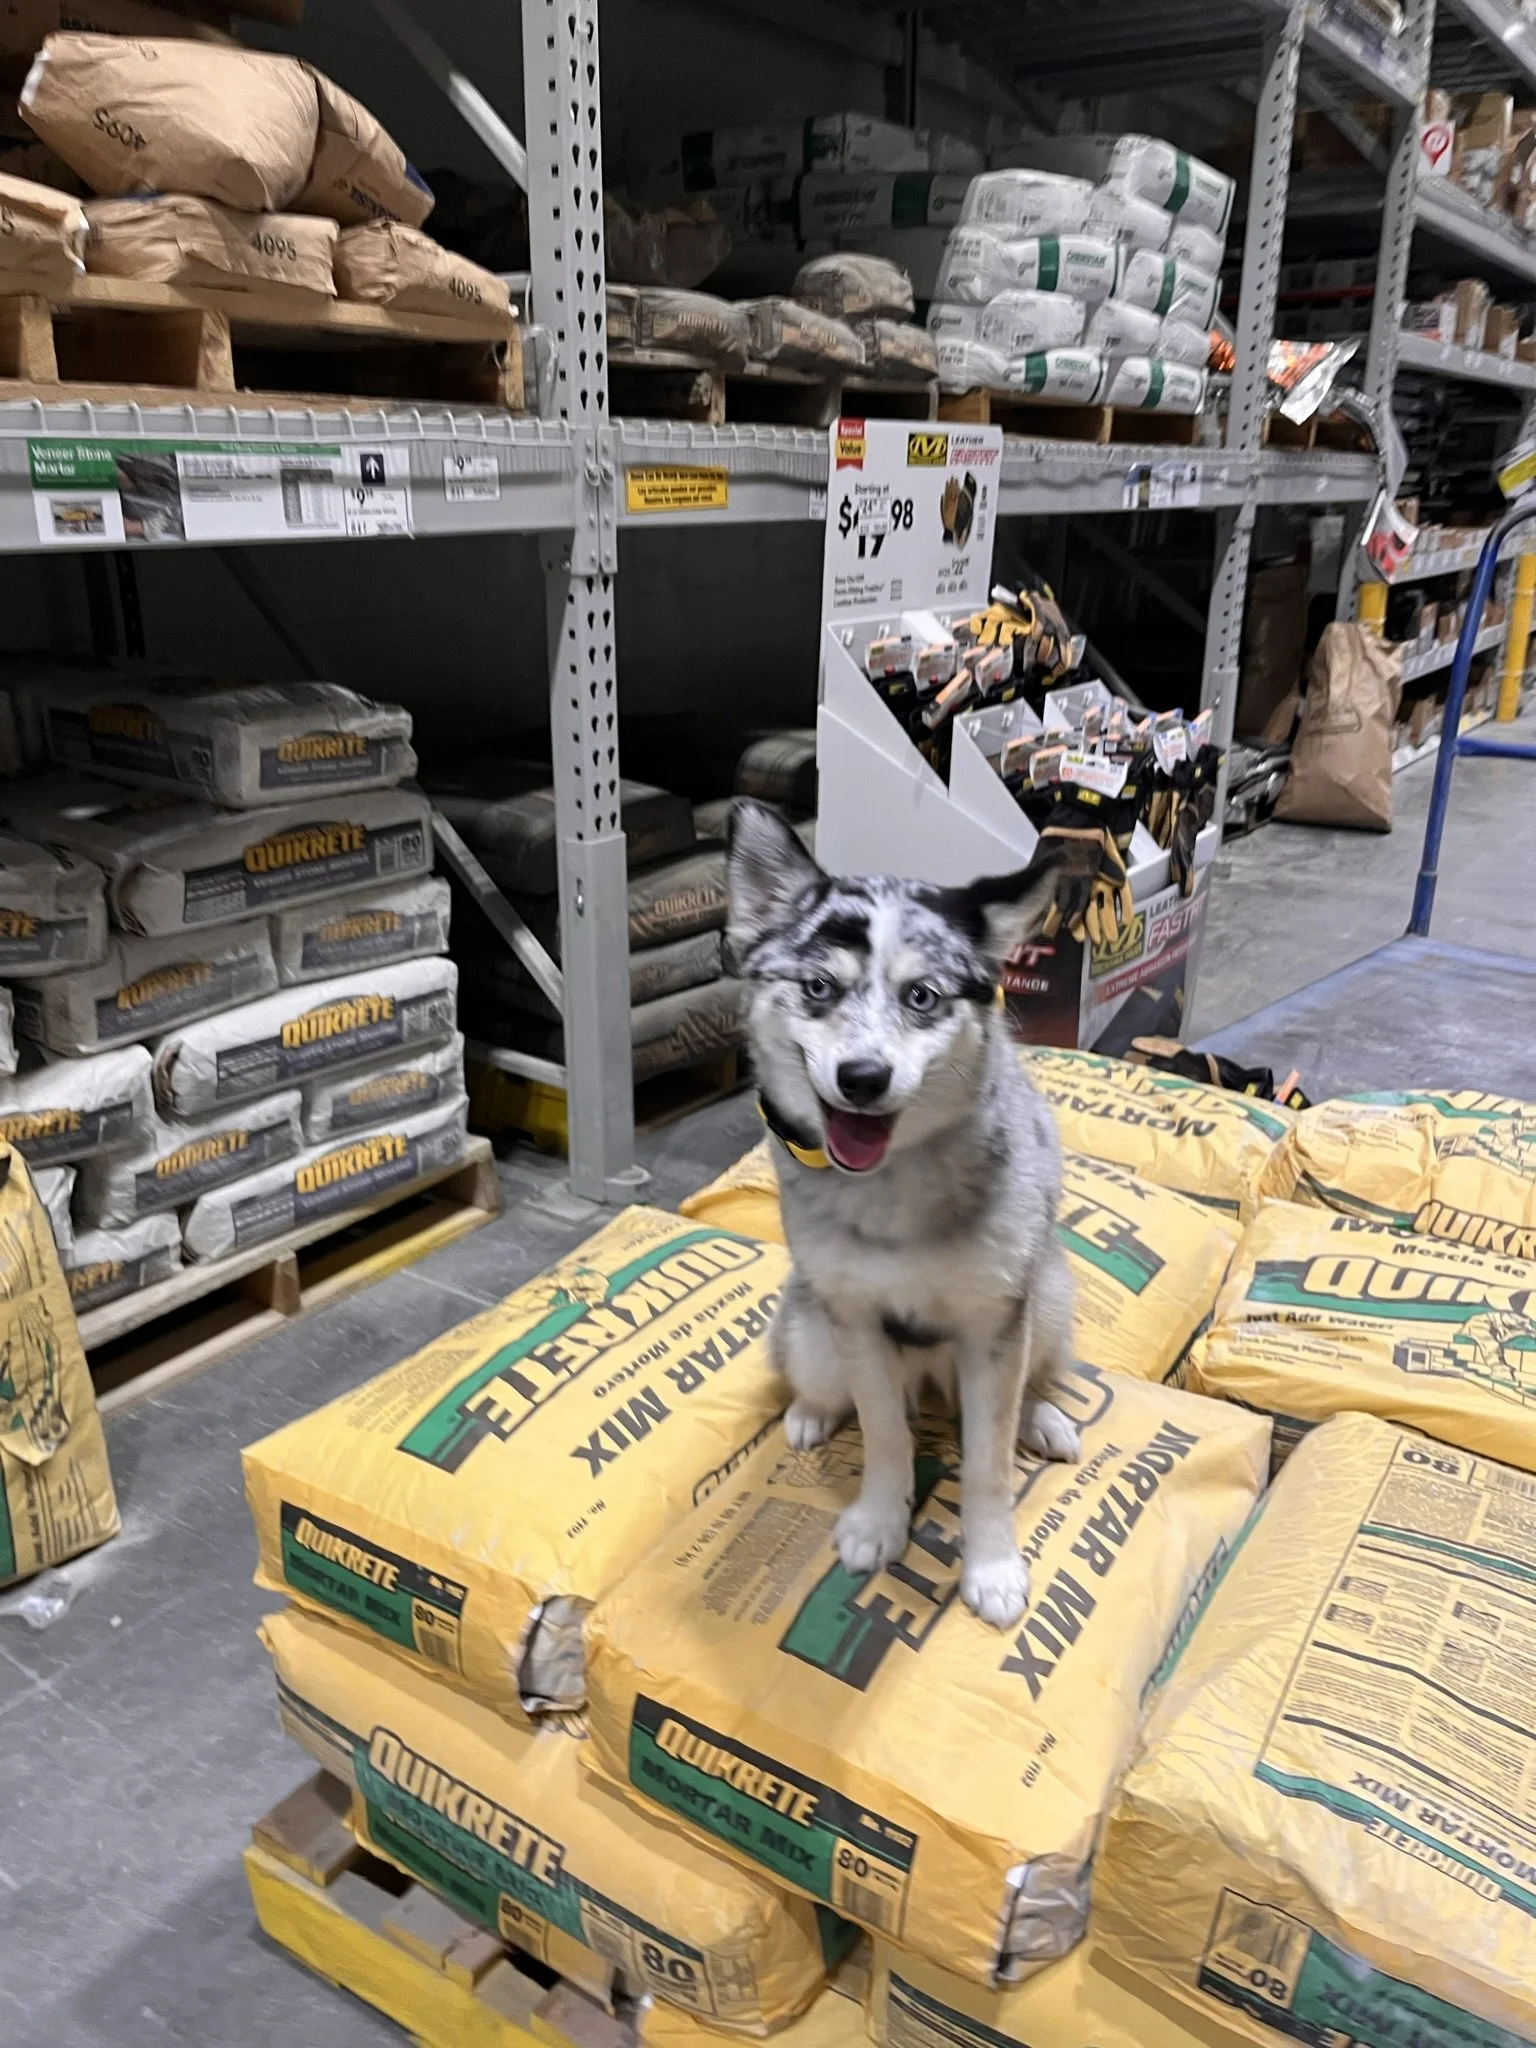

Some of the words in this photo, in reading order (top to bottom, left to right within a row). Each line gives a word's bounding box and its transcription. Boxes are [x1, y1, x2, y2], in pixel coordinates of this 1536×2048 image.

[252, 233, 298, 262] 4095
[448, 277, 483, 305] 4095
[840, 441, 862, 456] Value
[855, 484, 883, 496] Starting
[276, 730, 369, 765] QUIKRETE
[243, 820, 367, 874] QUIKRETE
[280, 992, 397, 1052] QUIKRETE
[154, 1129, 252, 1180] QUIKRETE
[295, 1132, 410, 1195] QUIKRETE
[1412, 1199, 1536, 1262] QUIKR
[1392, 1243, 1484, 1267] Mezcla
[1494, 1263, 1526, 1278] de
[693, 1280, 754, 1324] Mezcla
[456, 1236, 764, 1443] QUIKRETE
[663, 1287, 781, 1396] ORTAR
[669, 1321, 694, 1341] de
[592, 1339, 672, 1399] Mortero
[569, 1385, 674, 1480] MIX
[1402, 1449, 1462, 1476] 80
[1057, 1488, 1086, 1507] de
[1069, 1420, 1200, 1578] MORTAR
[293, 1517, 401, 1594] QUIKRETE
[1022, 1506, 1068, 1569] Morte
[414, 1604, 435, 1627] 80
[1000, 1567, 1097, 1702] MIX
[1032, 1731, 1058, 1757] No.
[654, 1717, 821, 1829] QUIKRETE
[1349, 1770, 1407, 1814] MIX
[367, 1724, 569, 1888] QUIKRETE
[640, 1757, 753, 1838] MORTAR
[764, 1826, 817, 1873] MIX
[836, 1847, 870, 1879] 80
[1364, 1815, 1505, 1904] QUIKRETE
[642, 1942, 697, 1985] 80
[1249, 1966, 1289, 2002] 80
